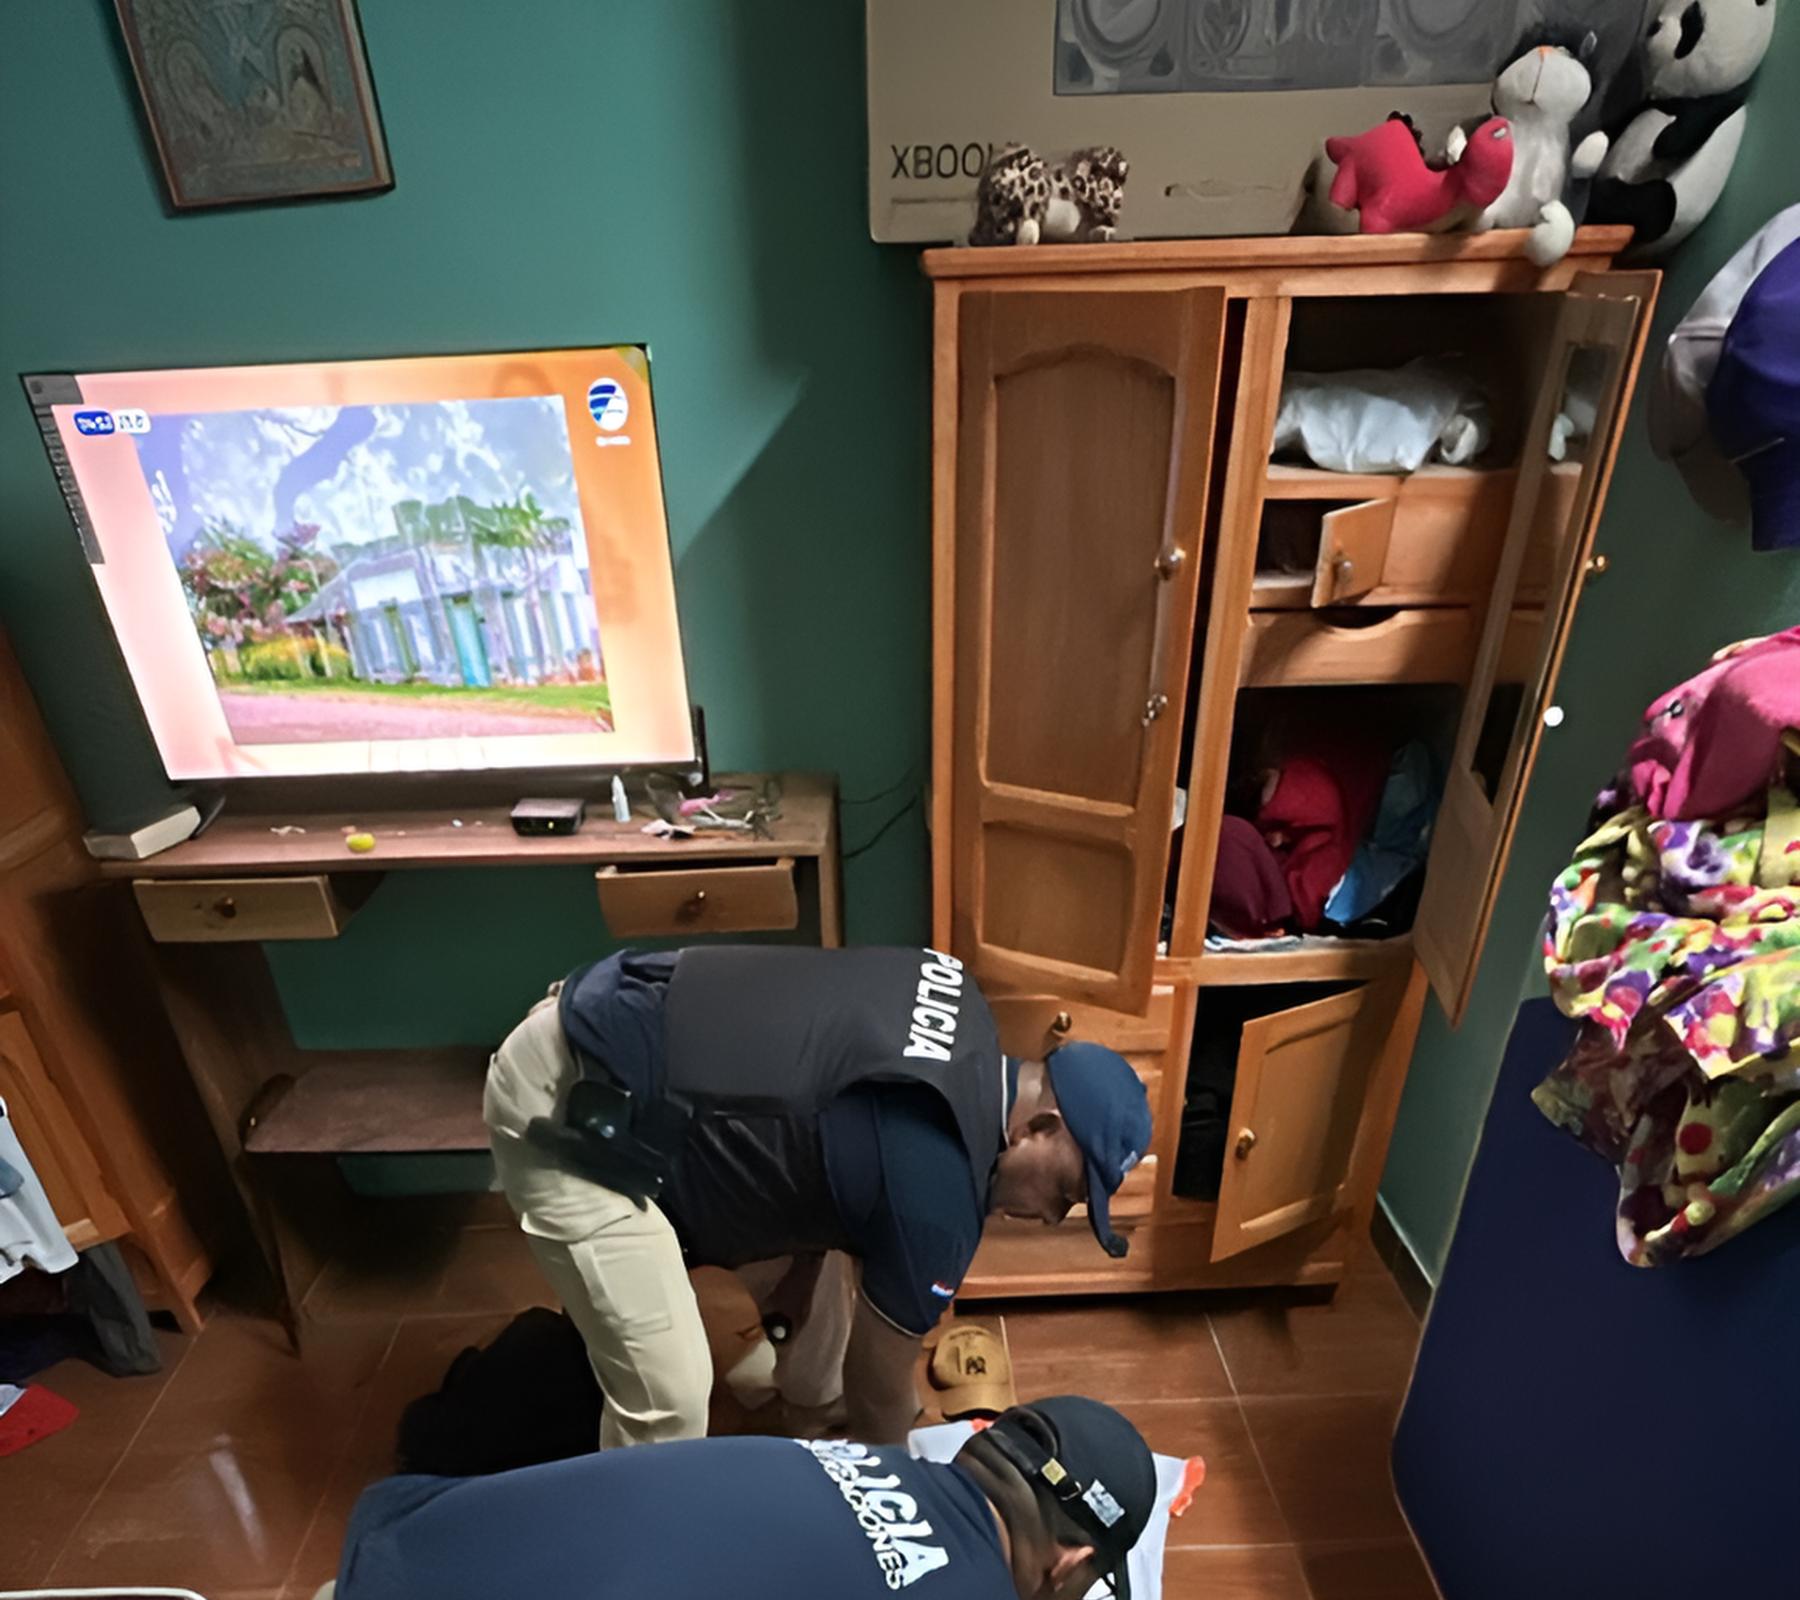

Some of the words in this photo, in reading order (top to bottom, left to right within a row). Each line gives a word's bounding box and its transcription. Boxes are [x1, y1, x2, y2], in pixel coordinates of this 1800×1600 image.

[890, 142, 993, 179] XBOO
[903, 947, 964, 1062] POLICIA
[811, 1438, 949, 1587] OLICIA
